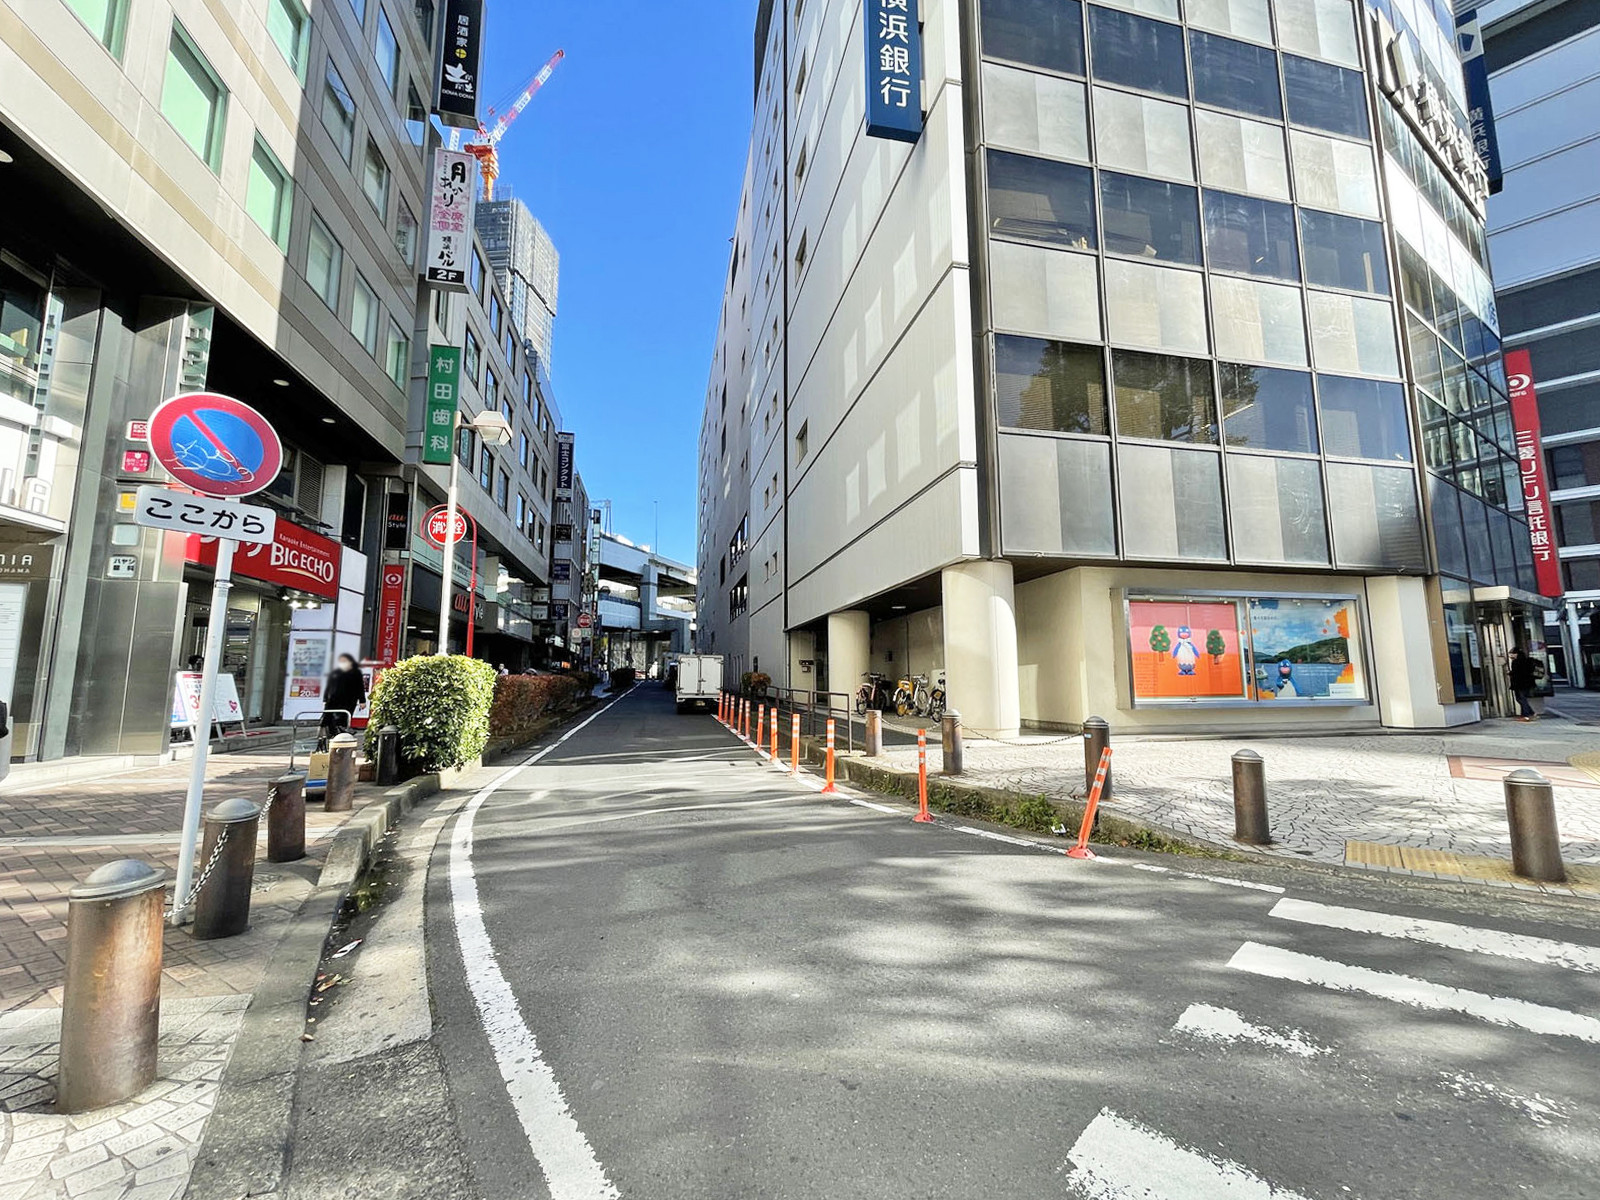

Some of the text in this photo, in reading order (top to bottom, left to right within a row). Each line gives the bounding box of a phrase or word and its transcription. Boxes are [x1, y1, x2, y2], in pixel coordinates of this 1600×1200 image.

[436, 269, 457, 281] 2F
[430, 356, 455, 452] 村田歯科
[146, 497, 265, 534] ここから
[270, 541, 299, 567] BIG
[300, 553, 334, 582] ECHO
